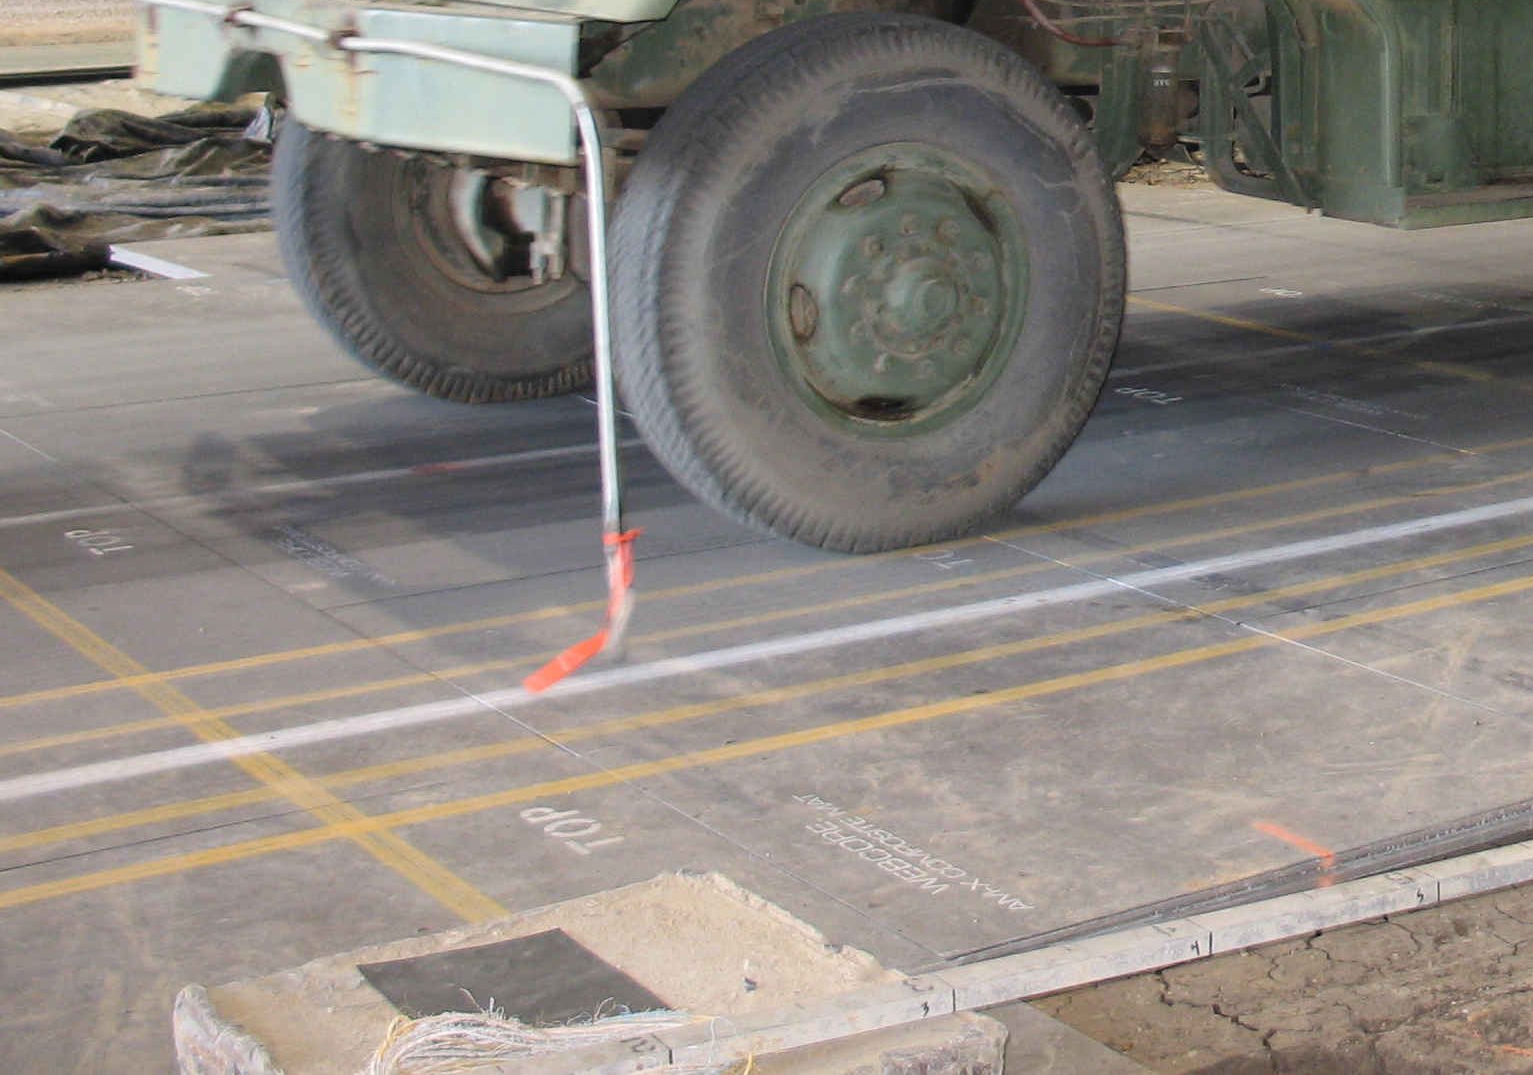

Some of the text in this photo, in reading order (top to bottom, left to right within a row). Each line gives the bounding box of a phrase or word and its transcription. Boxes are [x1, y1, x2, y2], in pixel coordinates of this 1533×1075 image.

[1114, 387, 1182, 405] TOP
[64, 529, 134, 555] TOP
[519, 806, 625, 855] TOP
[792, 793, 1035, 910] AM-X COMPOSITE MAT
[804, 819, 950, 895] WEBCORE
[1190, 939, 1201, 957] 4
